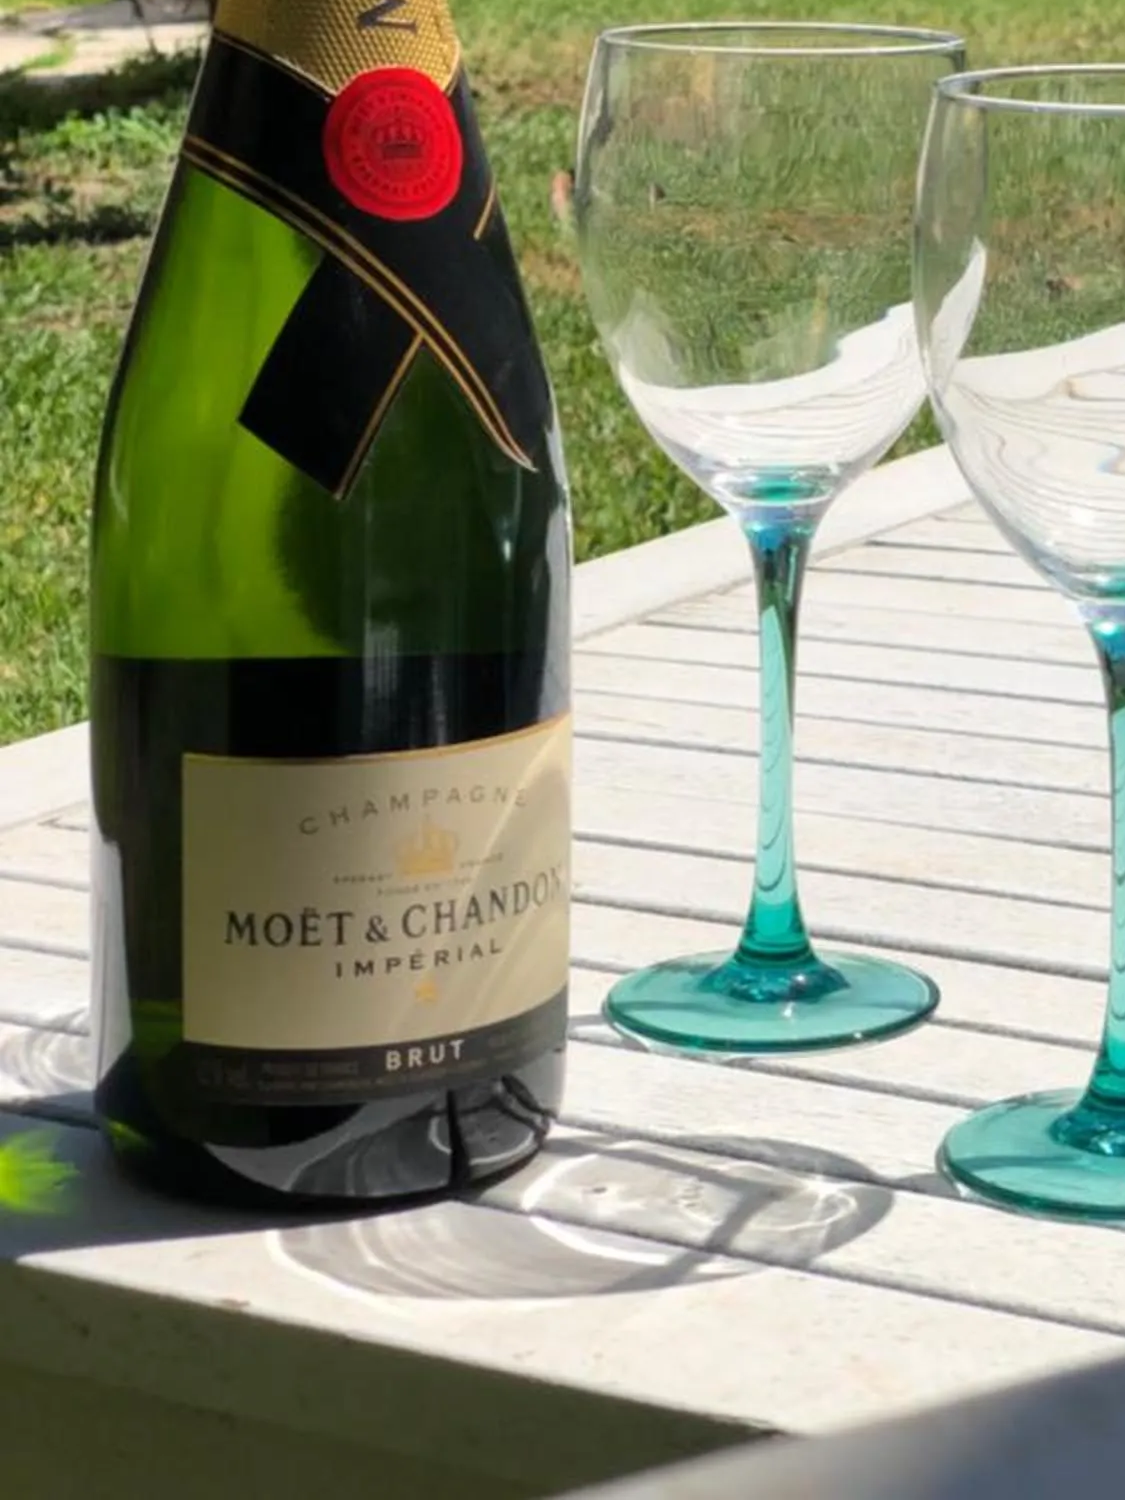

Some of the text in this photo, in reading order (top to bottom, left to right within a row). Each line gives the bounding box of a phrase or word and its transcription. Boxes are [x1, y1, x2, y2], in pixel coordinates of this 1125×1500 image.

[299, 784, 528, 835] CHAMPAGNE
[224, 906, 355, 948] MOËT
[364, 917, 390, 943] &
[401, 861, 564, 940] CHANDON
[335, 939, 504, 979] IMPÉRIAL
[385, 1038, 467, 1072] BRUT
